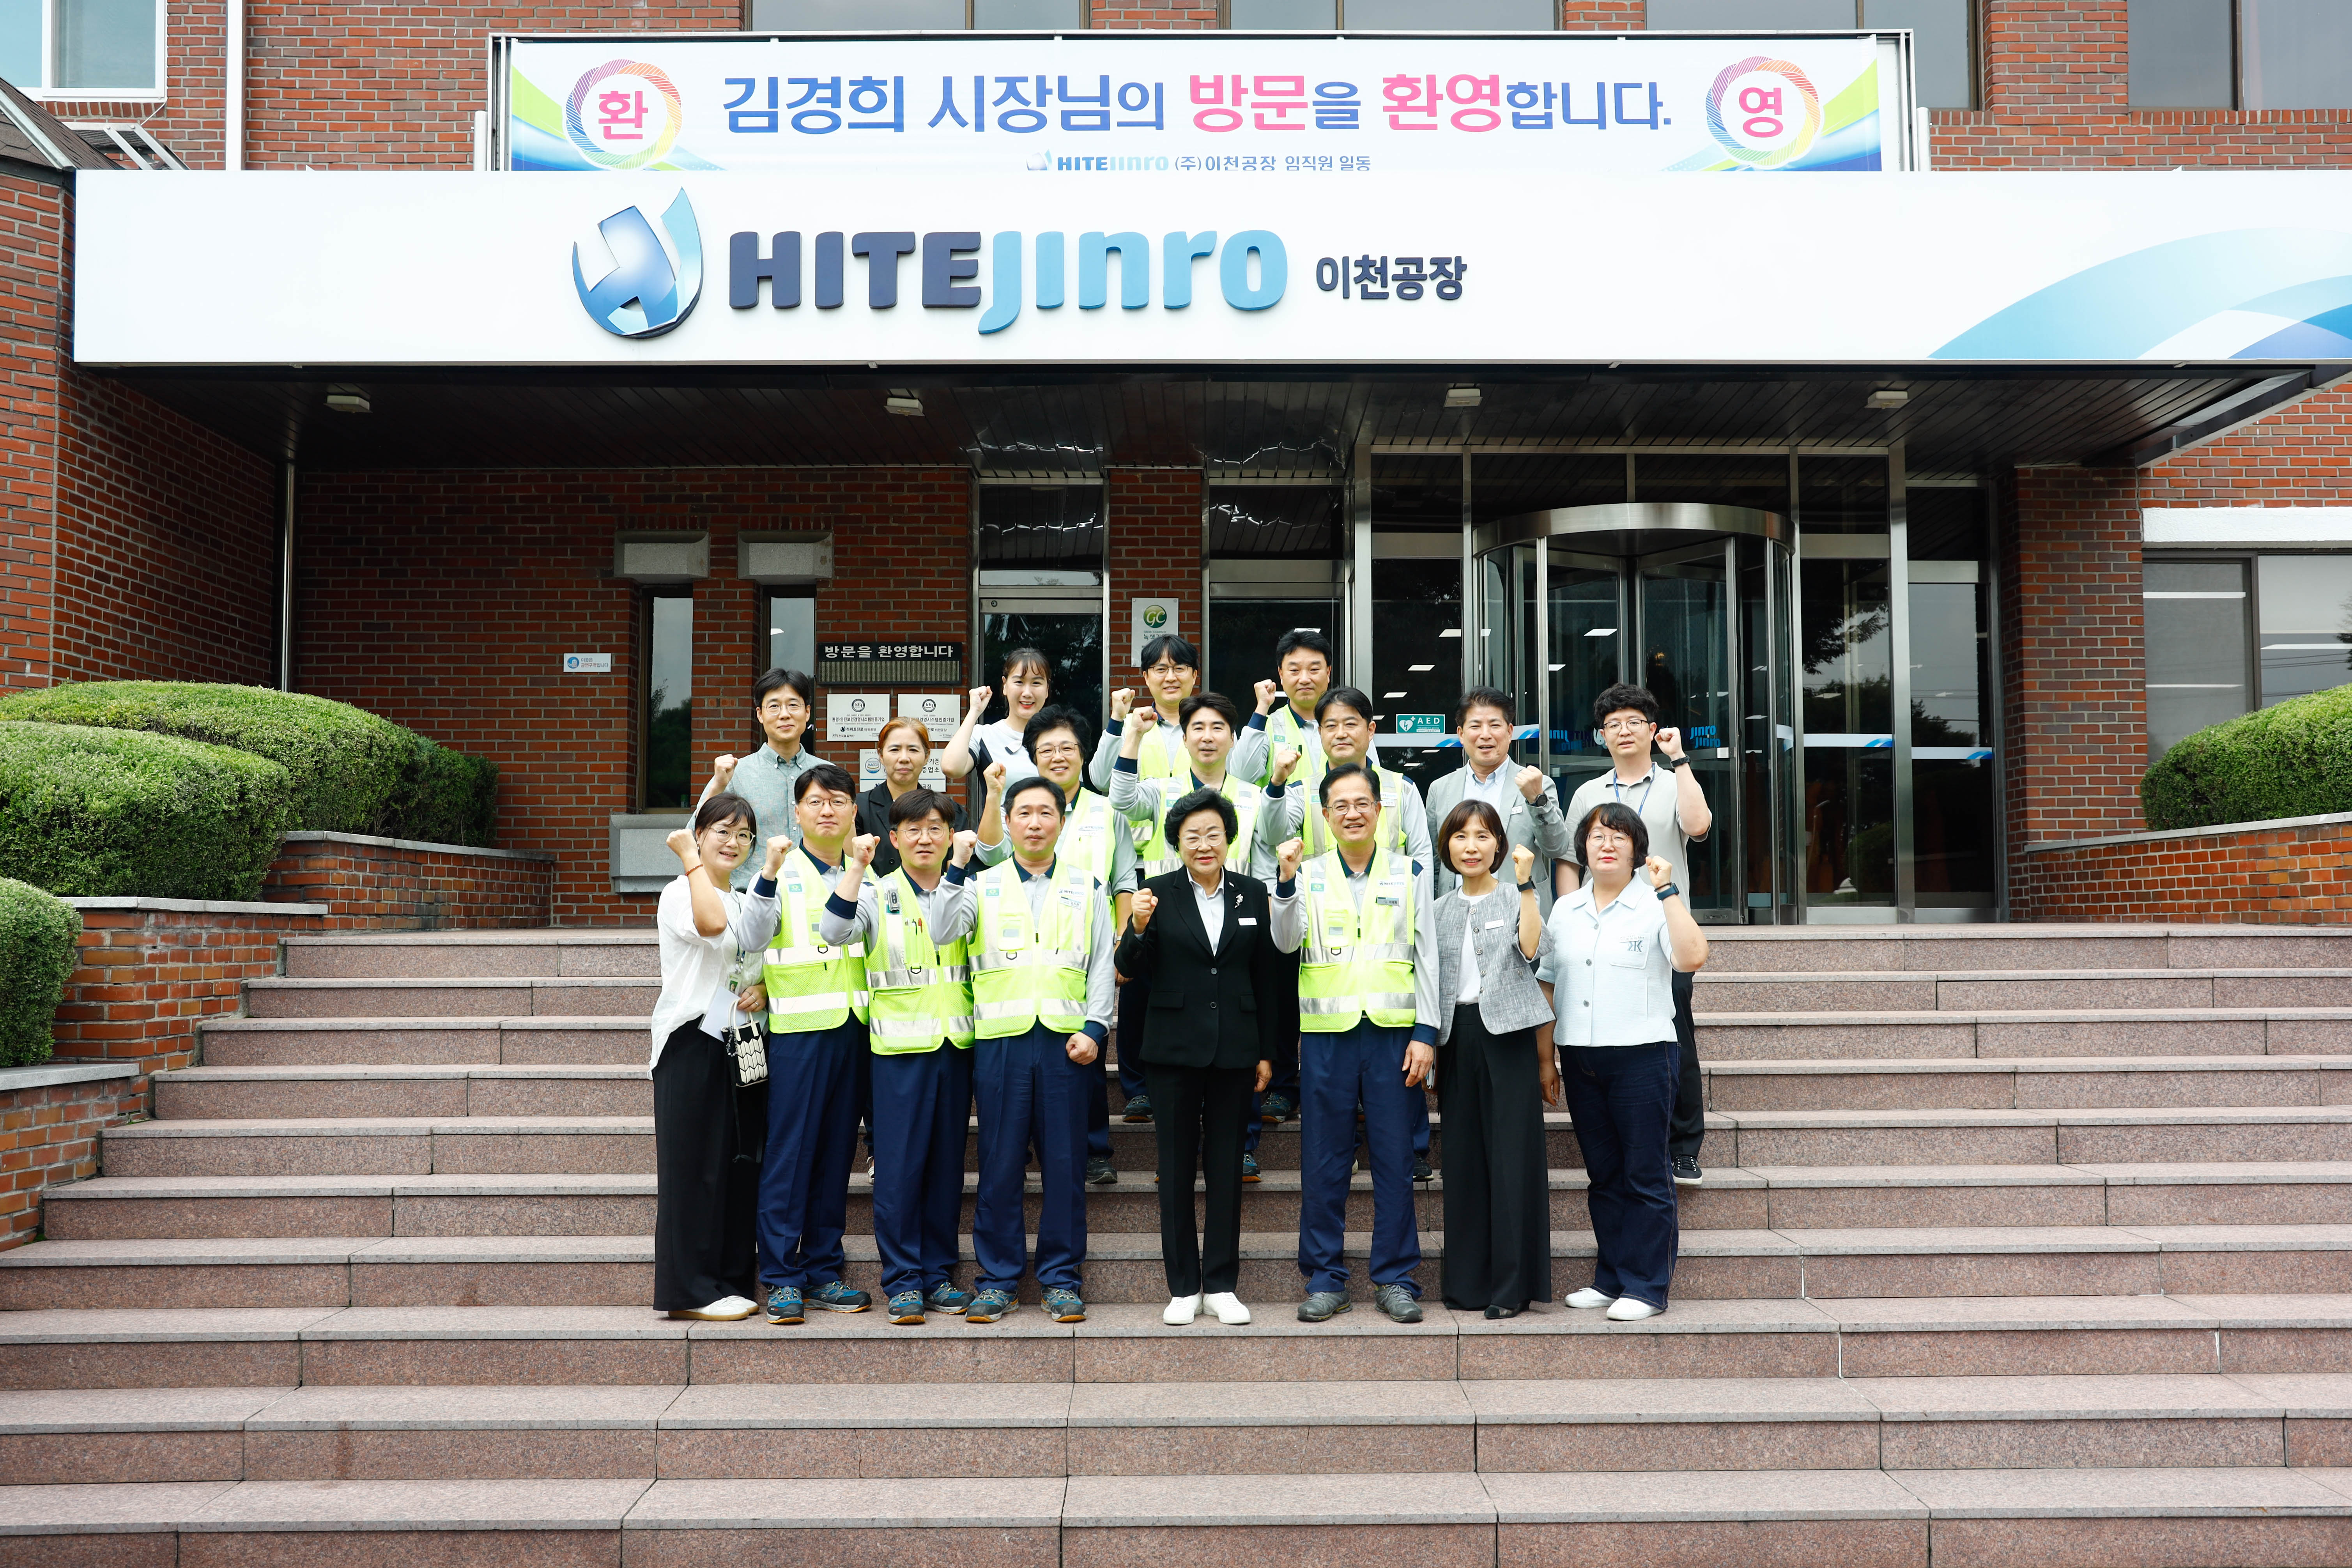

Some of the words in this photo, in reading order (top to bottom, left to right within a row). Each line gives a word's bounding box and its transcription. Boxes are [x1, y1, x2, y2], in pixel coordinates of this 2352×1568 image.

[598, 90, 649, 140] 환
[724, 76, 904, 135] 김경희
[928, 76, 1164, 134] 시장님의
[1190, 74, 1361, 133] 방문을
[1383, 74, 1672, 133] 환영합니다.
[1739, 87, 1783, 138] 영
[1175, 156, 1276, 171] (주)이천공장
[1285, 156, 1333, 171] 임직원
[1340, 156, 1371, 171] 일동
[1316, 254, 1468, 302] 이천공장
[825, 646, 872, 658] 방문을
[878, 645, 953, 658] 환영합니다
